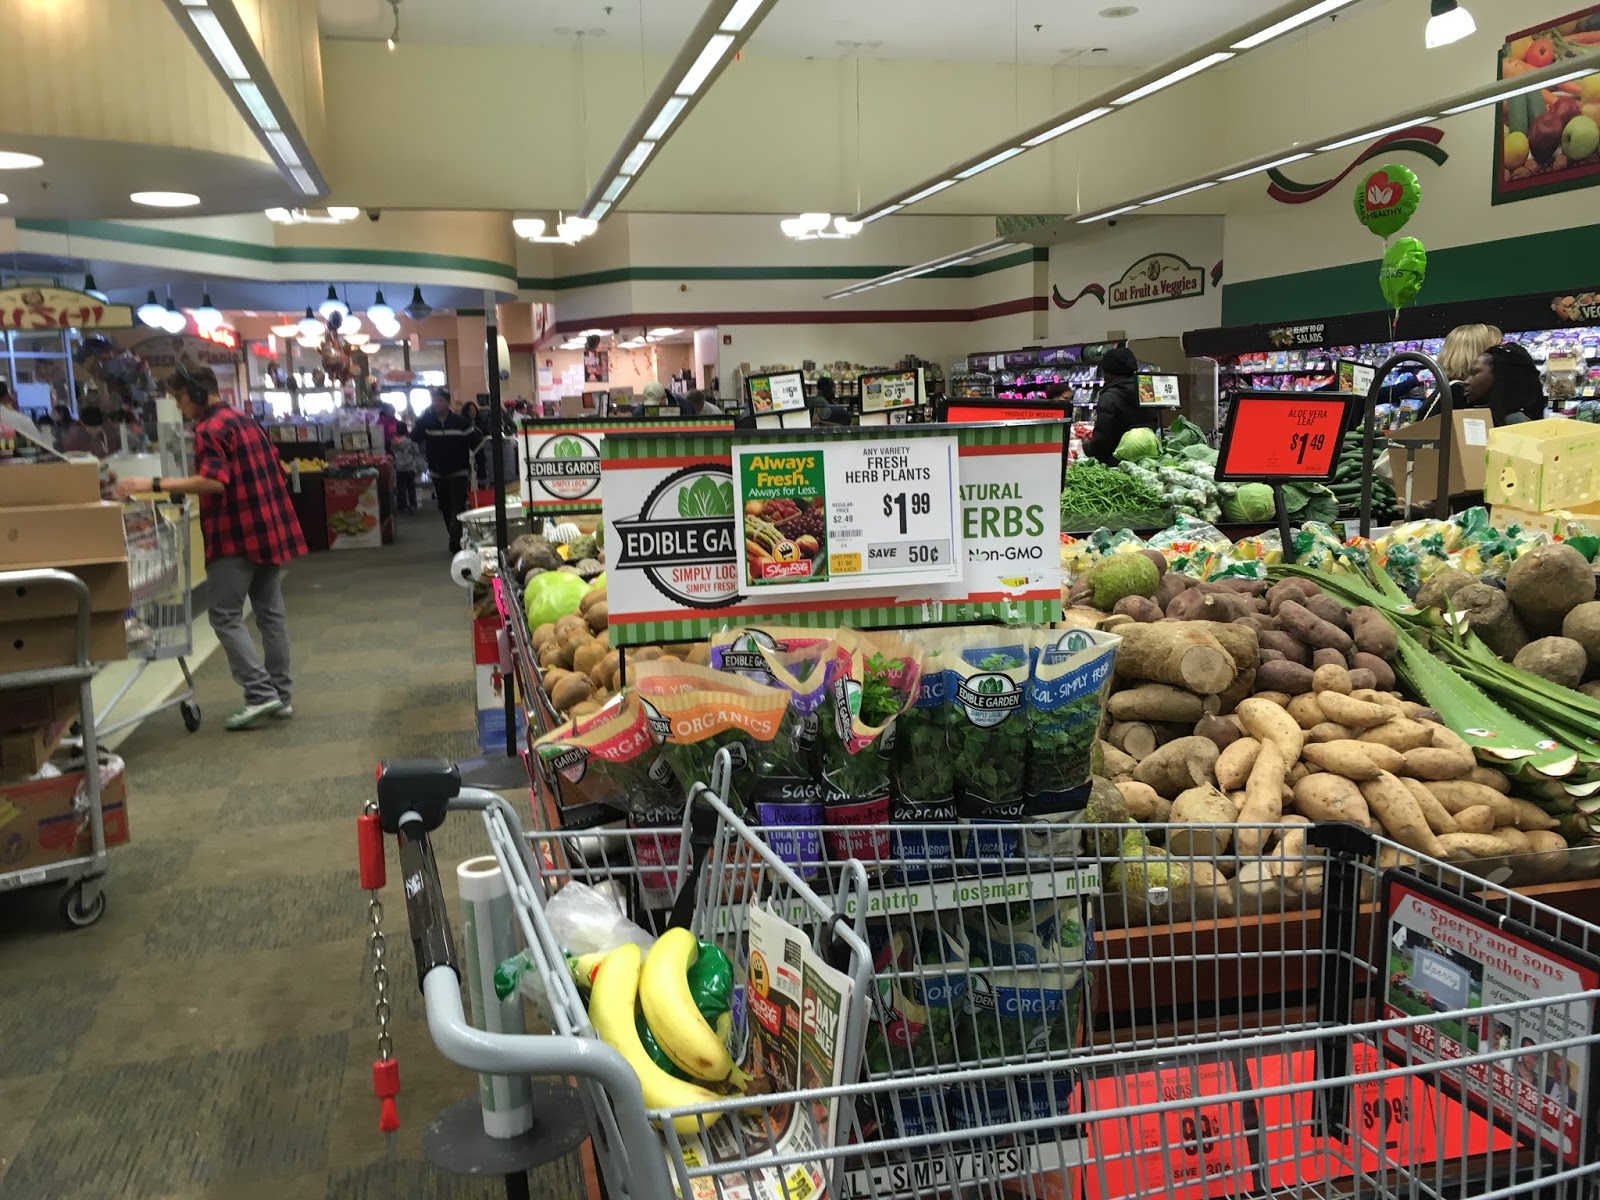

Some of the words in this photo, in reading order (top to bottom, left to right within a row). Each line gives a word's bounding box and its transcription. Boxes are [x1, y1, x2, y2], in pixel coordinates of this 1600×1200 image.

[1367, 207, 1402, 220] HEALTHY
[1114, 288, 1128, 302] Cut
[1130, 283, 1151, 299] Fruit
[1152, 285, 1159, 296] &
[1160, 276, 1197, 298] Veggies
[1293, 325, 1309, 334] READY
[1296, 333, 1324, 344] SALADS
[1288, 409, 1308, 418] ALOE
[1309, 409, 1327, 418] VERA
[1297, 417, 1315, 426] LEAF
[863, 447, 878, 456] ANY
[880, 446, 910, 455] VARIETY
[530, 462, 564, 476] EDIBLE
[565, 461, 599, 475] GARDE
[750, 456, 815, 471] Always
[867, 455, 908, 469] FRESH
[571, 479, 587, 487] LOCAL
[757, 470, 809, 487] Fresh.
[845, 470, 879, 484] HERB
[882, 467, 931, 482] PLANTS
[748, 487, 782, 499] Always
[782, 486, 795, 496] for
[797, 485, 818, 496] Less.
[833, 515, 854, 523] $2.49
[626, 529, 698, 558] EDIBLE
[703, 528, 737, 553] GA
[868, 548, 897, 559] SAVE
[909, 545, 939, 564] 50¢
[969, 545, 1043, 562] Non-GMO
[672, 567, 712, 583] SIMPLY
[716, 565, 738, 580] LOC
[766, 561, 809, 577] ShopRite
[686, 583, 711, 593] SIMPLY
[713, 581, 736, 591] FRESH
[725, 654, 754, 667] EDIBLE
[1059, 673, 1088, 699] SIMPLY
[959, 687, 985, 707] EDIBLE
[985, 693, 1020, 708] GARDEN
[676, 710, 772, 737] ORGANICS
[554, 748, 589, 770] GARDEN
[953, 880, 1034, 903] rosemary
[1066, 872, 1098, 890] min
[1412, 900, 1426, 916] G.
[1430, 908, 1483, 943] Sperry
[1486, 935, 1518, 960] and
[1522, 952, 1564, 982] sons
[1431, 926, 1464, 950] Gies
[1468, 942, 1541, 990] brothers
[1424, 960, 1460, 989] Sperry
[1485, 973, 1531, 1002] Monuments
[1490, 990, 1499, 999] of
[803, 997, 816, 1026] 2
[815, 995, 838, 1036] DAY
[1549, 1007, 1586, 1031] Marers
[815, 1028, 834, 1059] SALE!
[1174, 1167, 1197, 1179] SAVE
